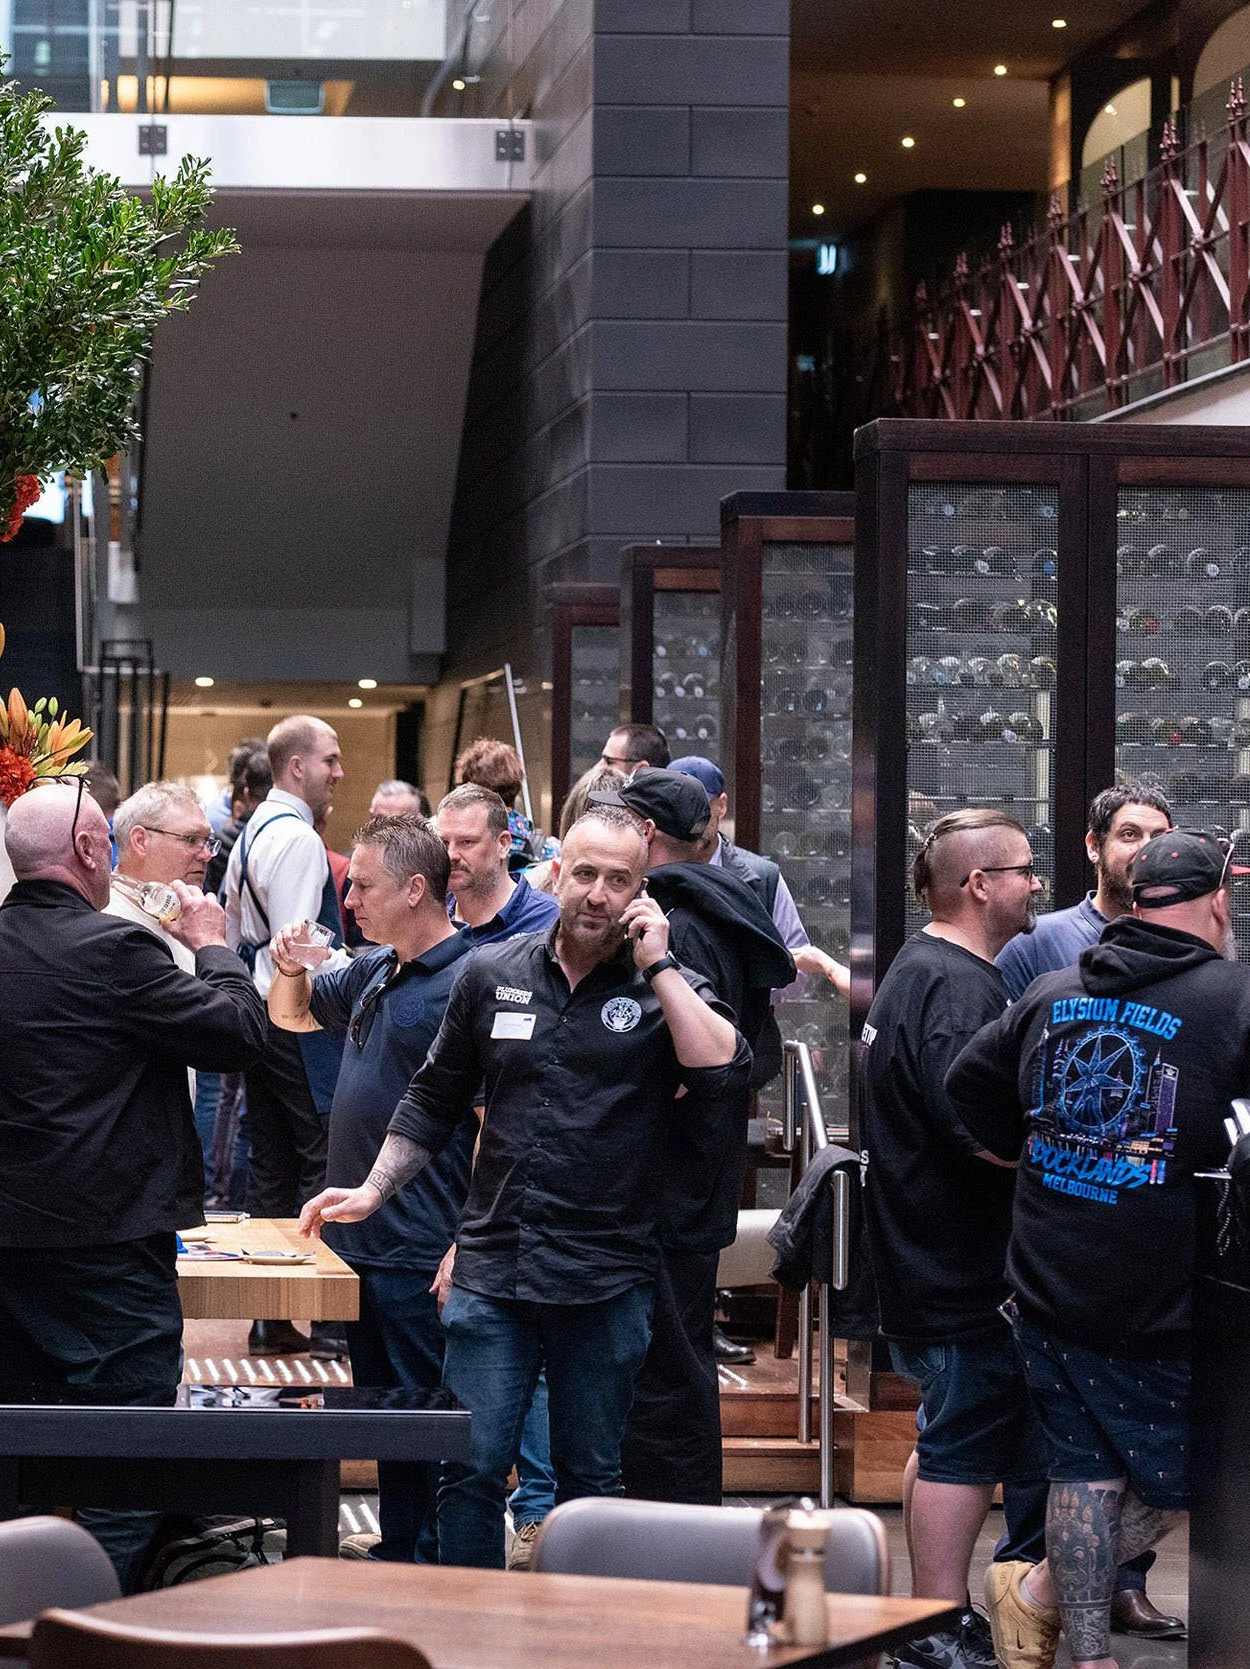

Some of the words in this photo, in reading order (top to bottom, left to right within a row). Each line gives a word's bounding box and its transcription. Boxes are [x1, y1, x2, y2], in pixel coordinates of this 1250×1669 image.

[495, 992, 531, 1005] UNION
[1052, 997, 1120, 1024] ELYSIUM
[1119, 1001, 1182, 1040] FIELDS
[1030, 1136, 1152, 1189] DOCKLANDS
[1042, 1172, 1118, 1205] MELBOURNE
